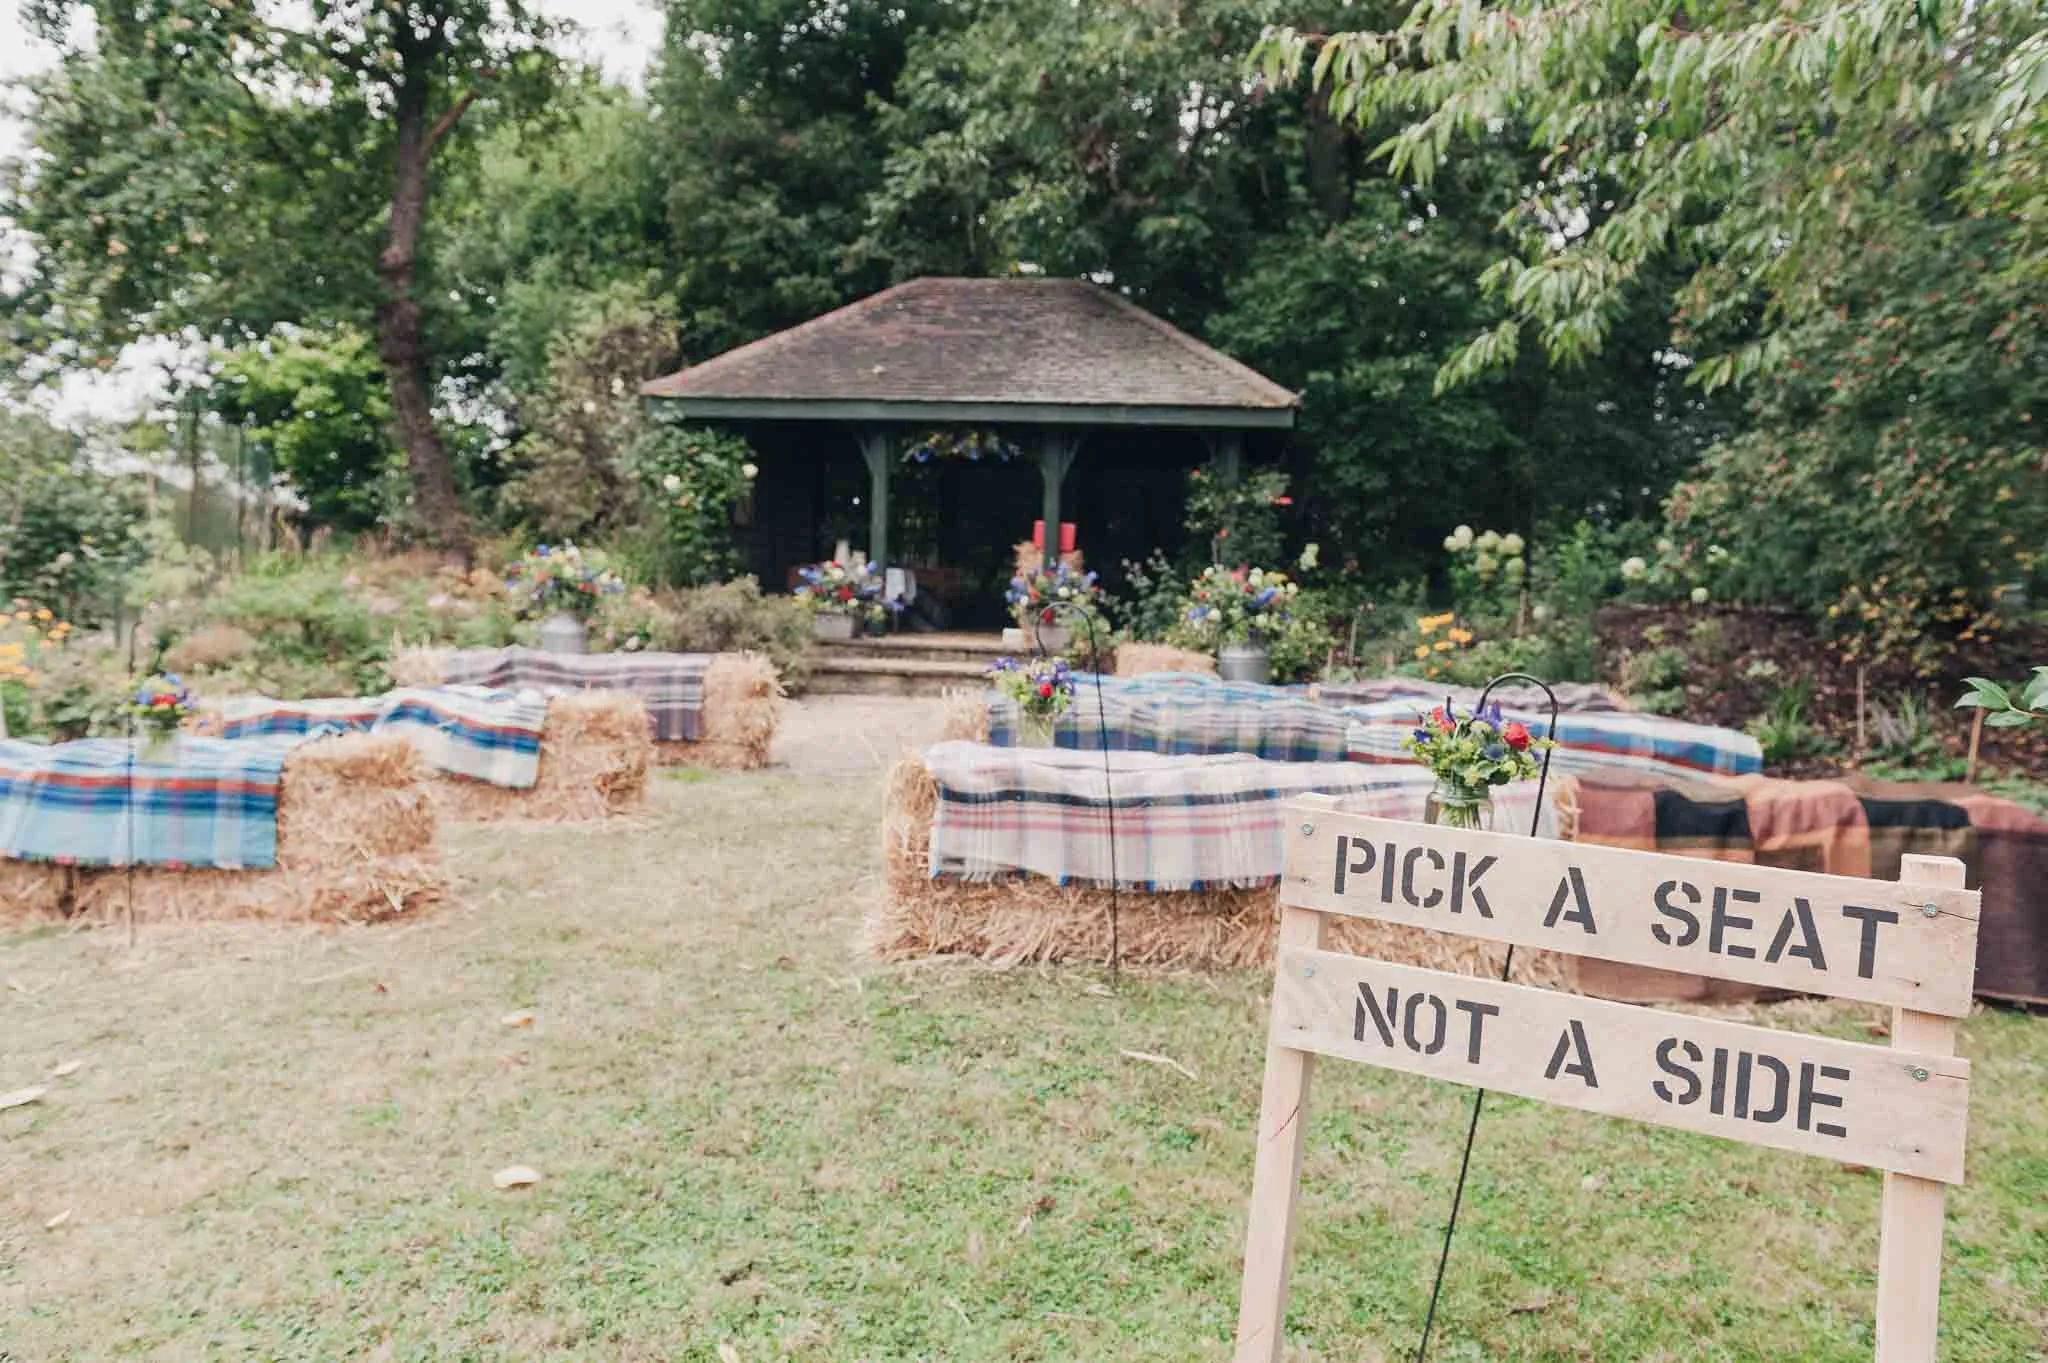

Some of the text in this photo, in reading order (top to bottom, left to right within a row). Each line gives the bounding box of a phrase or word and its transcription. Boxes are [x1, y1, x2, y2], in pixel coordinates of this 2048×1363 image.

[1334, 835, 1899, 980] PICK A SEAT
[1353, 981, 1851, 1139] NOT A SIDE
